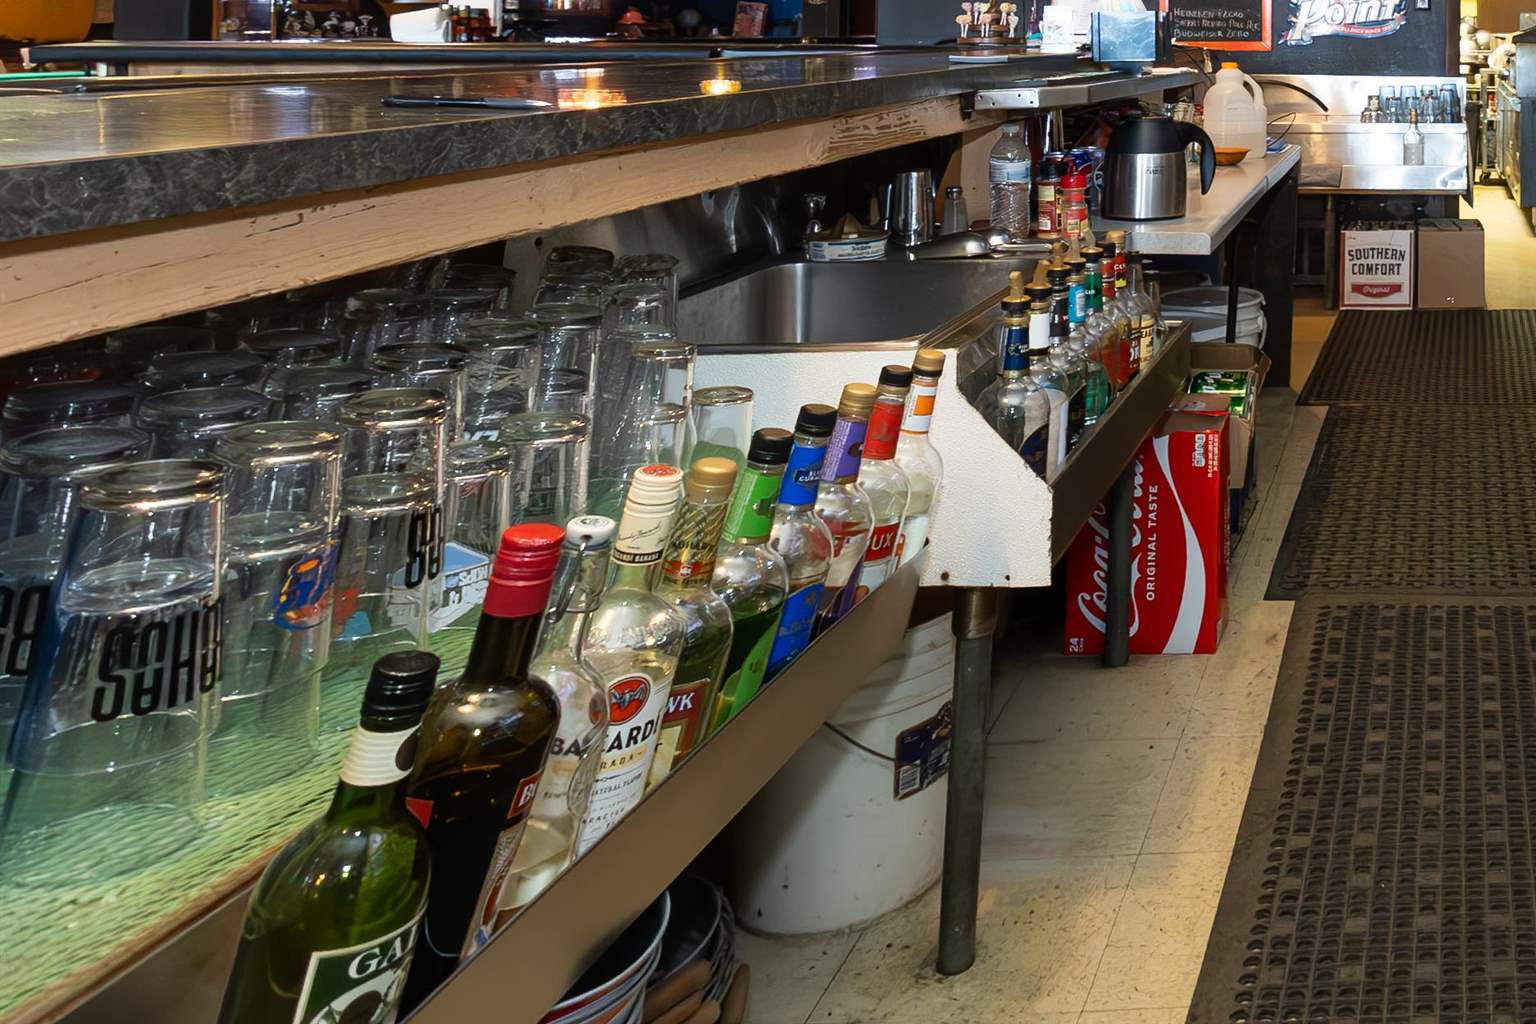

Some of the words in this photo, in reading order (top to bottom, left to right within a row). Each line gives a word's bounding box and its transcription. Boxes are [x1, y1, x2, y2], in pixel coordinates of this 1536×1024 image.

[1347, 247, 1407, 262] SOUTHERN
[1351, 263, 1402, 276] COMFORT
[1148, 484, 1159, 532] TASTE
[1146, 533, 1158, 602] ORIGINAL
[1069, 637, 1080, 653] 24
